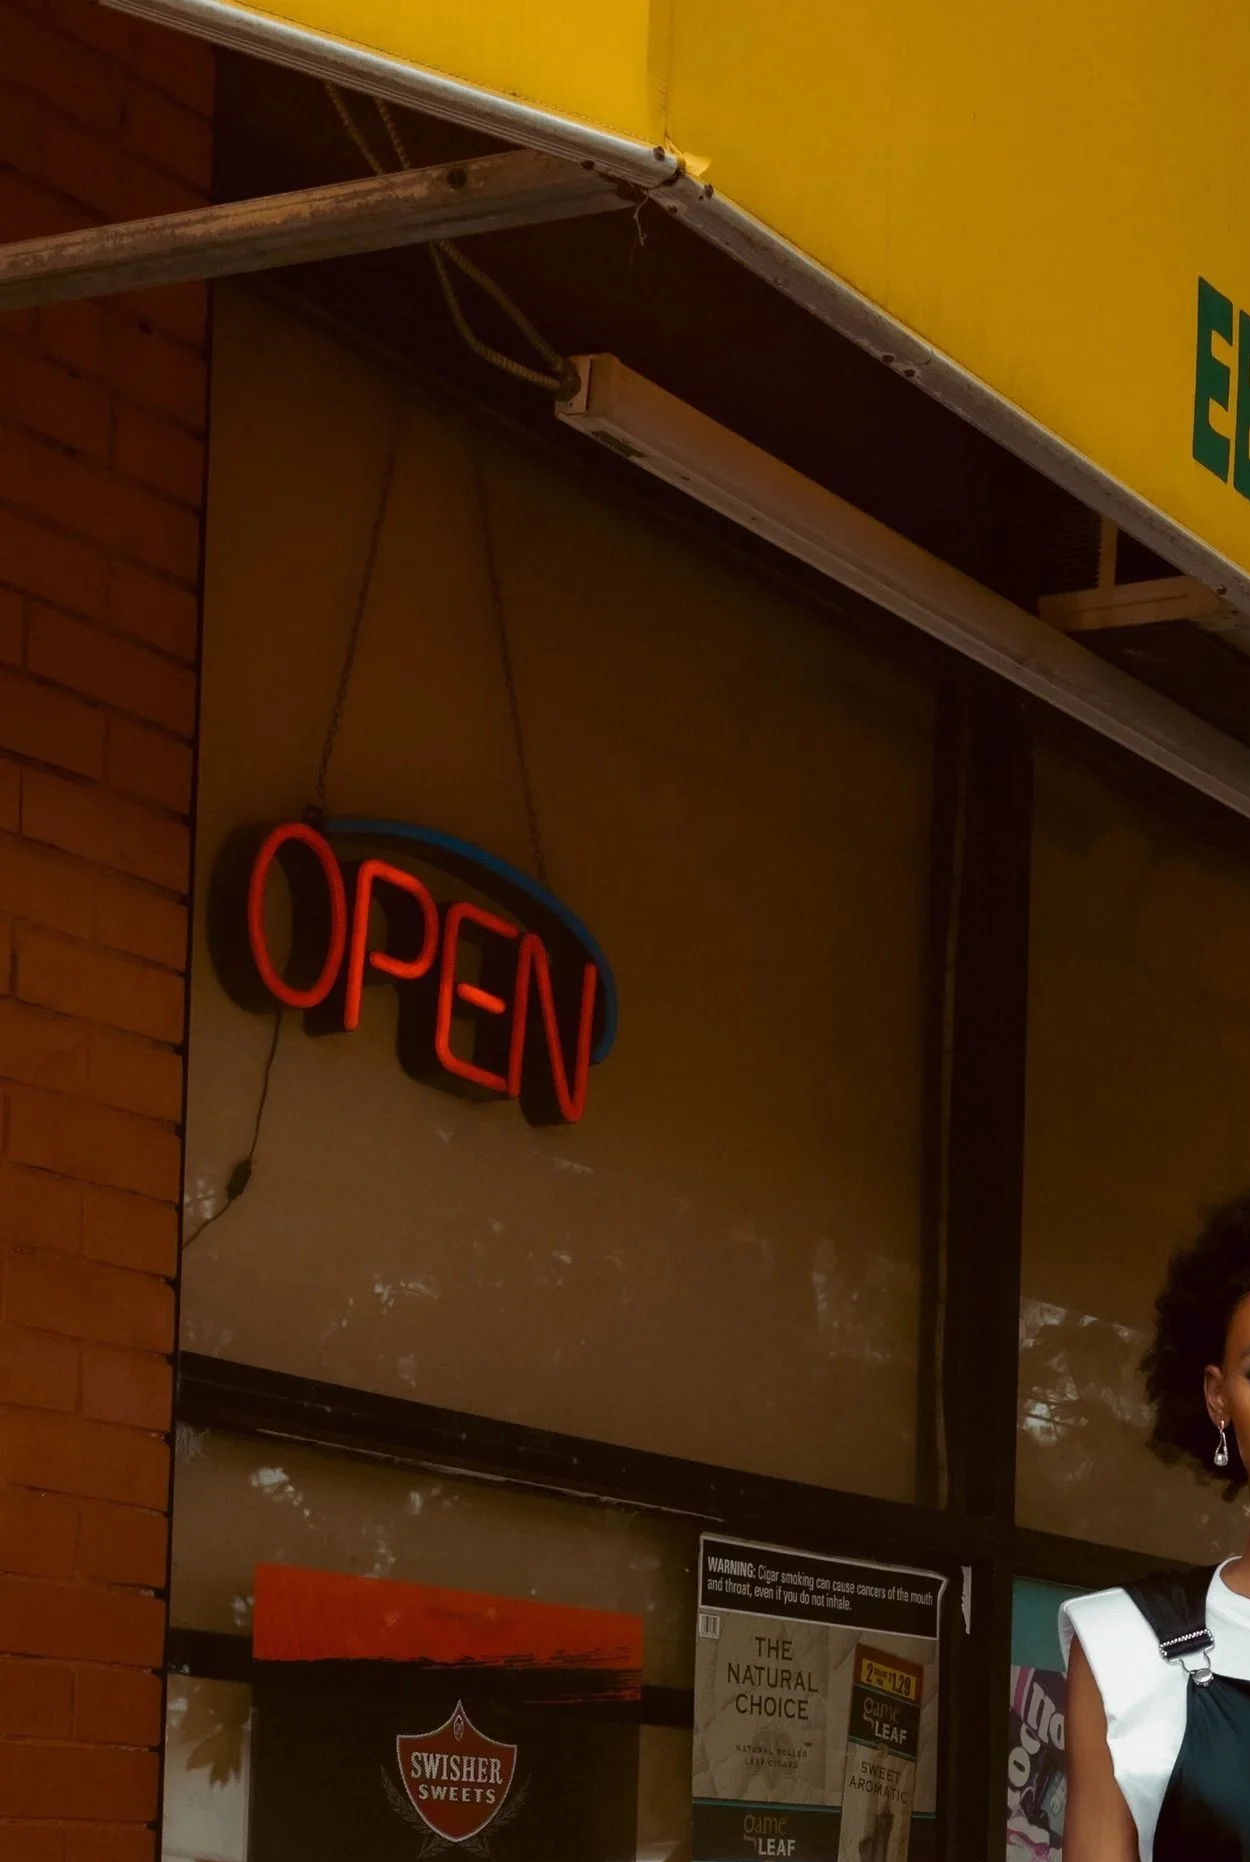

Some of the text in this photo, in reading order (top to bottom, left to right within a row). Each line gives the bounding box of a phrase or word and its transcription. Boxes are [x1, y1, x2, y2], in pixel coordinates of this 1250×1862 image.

[248, 821, 597, 1123] OPEN
[707, 1555, 933, 1606] WARNING: Cigar smoking can cause cancers of the mouth
[707, 1577, 852, 1612] and throat, even if you do not inhale.
[754, 1636, 793, 1661] THE
[727, 1662, 818, 1693] NATURAL
[866, 1662, 873, 1683] 2
[735, 1693, 809, 1721] CHOICE
[863, 1696, 900, 1730] game
[874, 1720, 908, 1745] LEAF
[411, 1751, 503, 1784] SWISHER
[860, 1760, 902, 1782] SWEET
[418, 1784, 496, 1804] SWEETS
[849, 1776, 909, 1804] AROMATIC
[743, 1814, 787, 1850] game
[759, 1838, 796, 1857] LEAF
